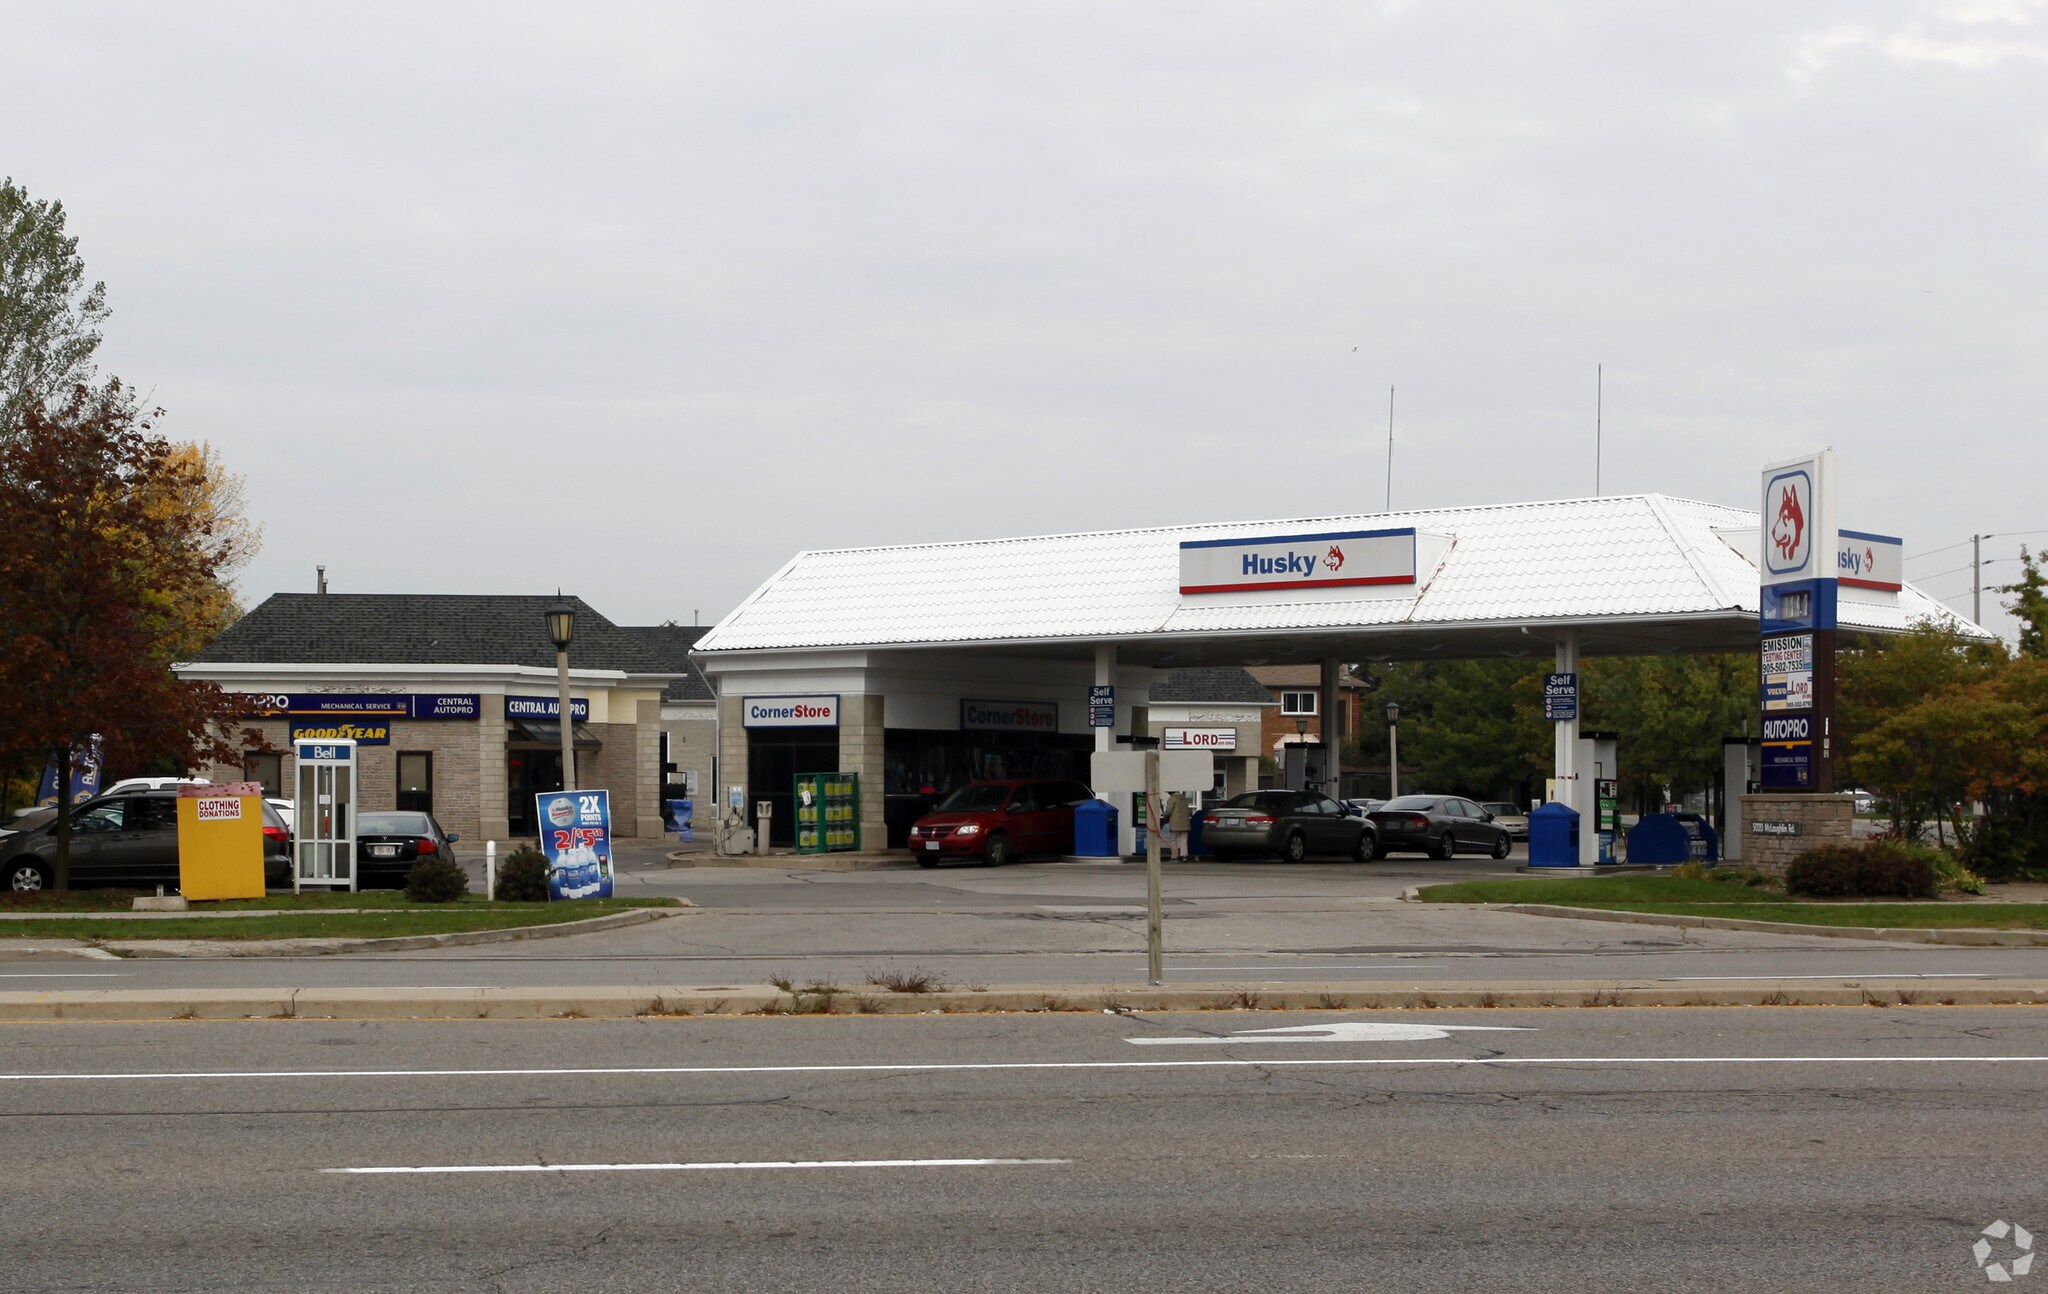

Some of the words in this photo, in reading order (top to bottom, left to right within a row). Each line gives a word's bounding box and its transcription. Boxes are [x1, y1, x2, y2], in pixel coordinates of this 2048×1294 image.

[1242, 551, 1317, 577] Husky
[1762, 636, 1802, 653] EMISSION
[1763, 651, 1783, 663] TESTING
[1784, 649, 1802, 660] CENTER
[1762, 659, 1803, 674] 905-502-7535
[1550, 675, 1571, 685] Self
[1093, 687, 1110, 696] Self
[1546, 685, 1575, 695] Serve
[1767, 687, 1787, 696] VOLVO
[1791, 680, 1808, 695] LORD
[437, 698, 473, 706] CENTRAL
[1090, 696, 1113, 705] Serve
[433, 706, 473, 714] AUTOPRO
[509, 701, 546, 713] CENTRAL
[547, 703, 586, 715] AUPRO
[751, 705, 831, 718] CornerStore
[1764, 719, 1808, 739] AUTOPRO
[1183, 731, 1219, 745] LORD
[314, 746, 336, 759] Bell
[199, 801, 240, 811] CLOTHING
[579, 796, 600, 813] 2X
[199, 810, 240, 818] DONATIONS
